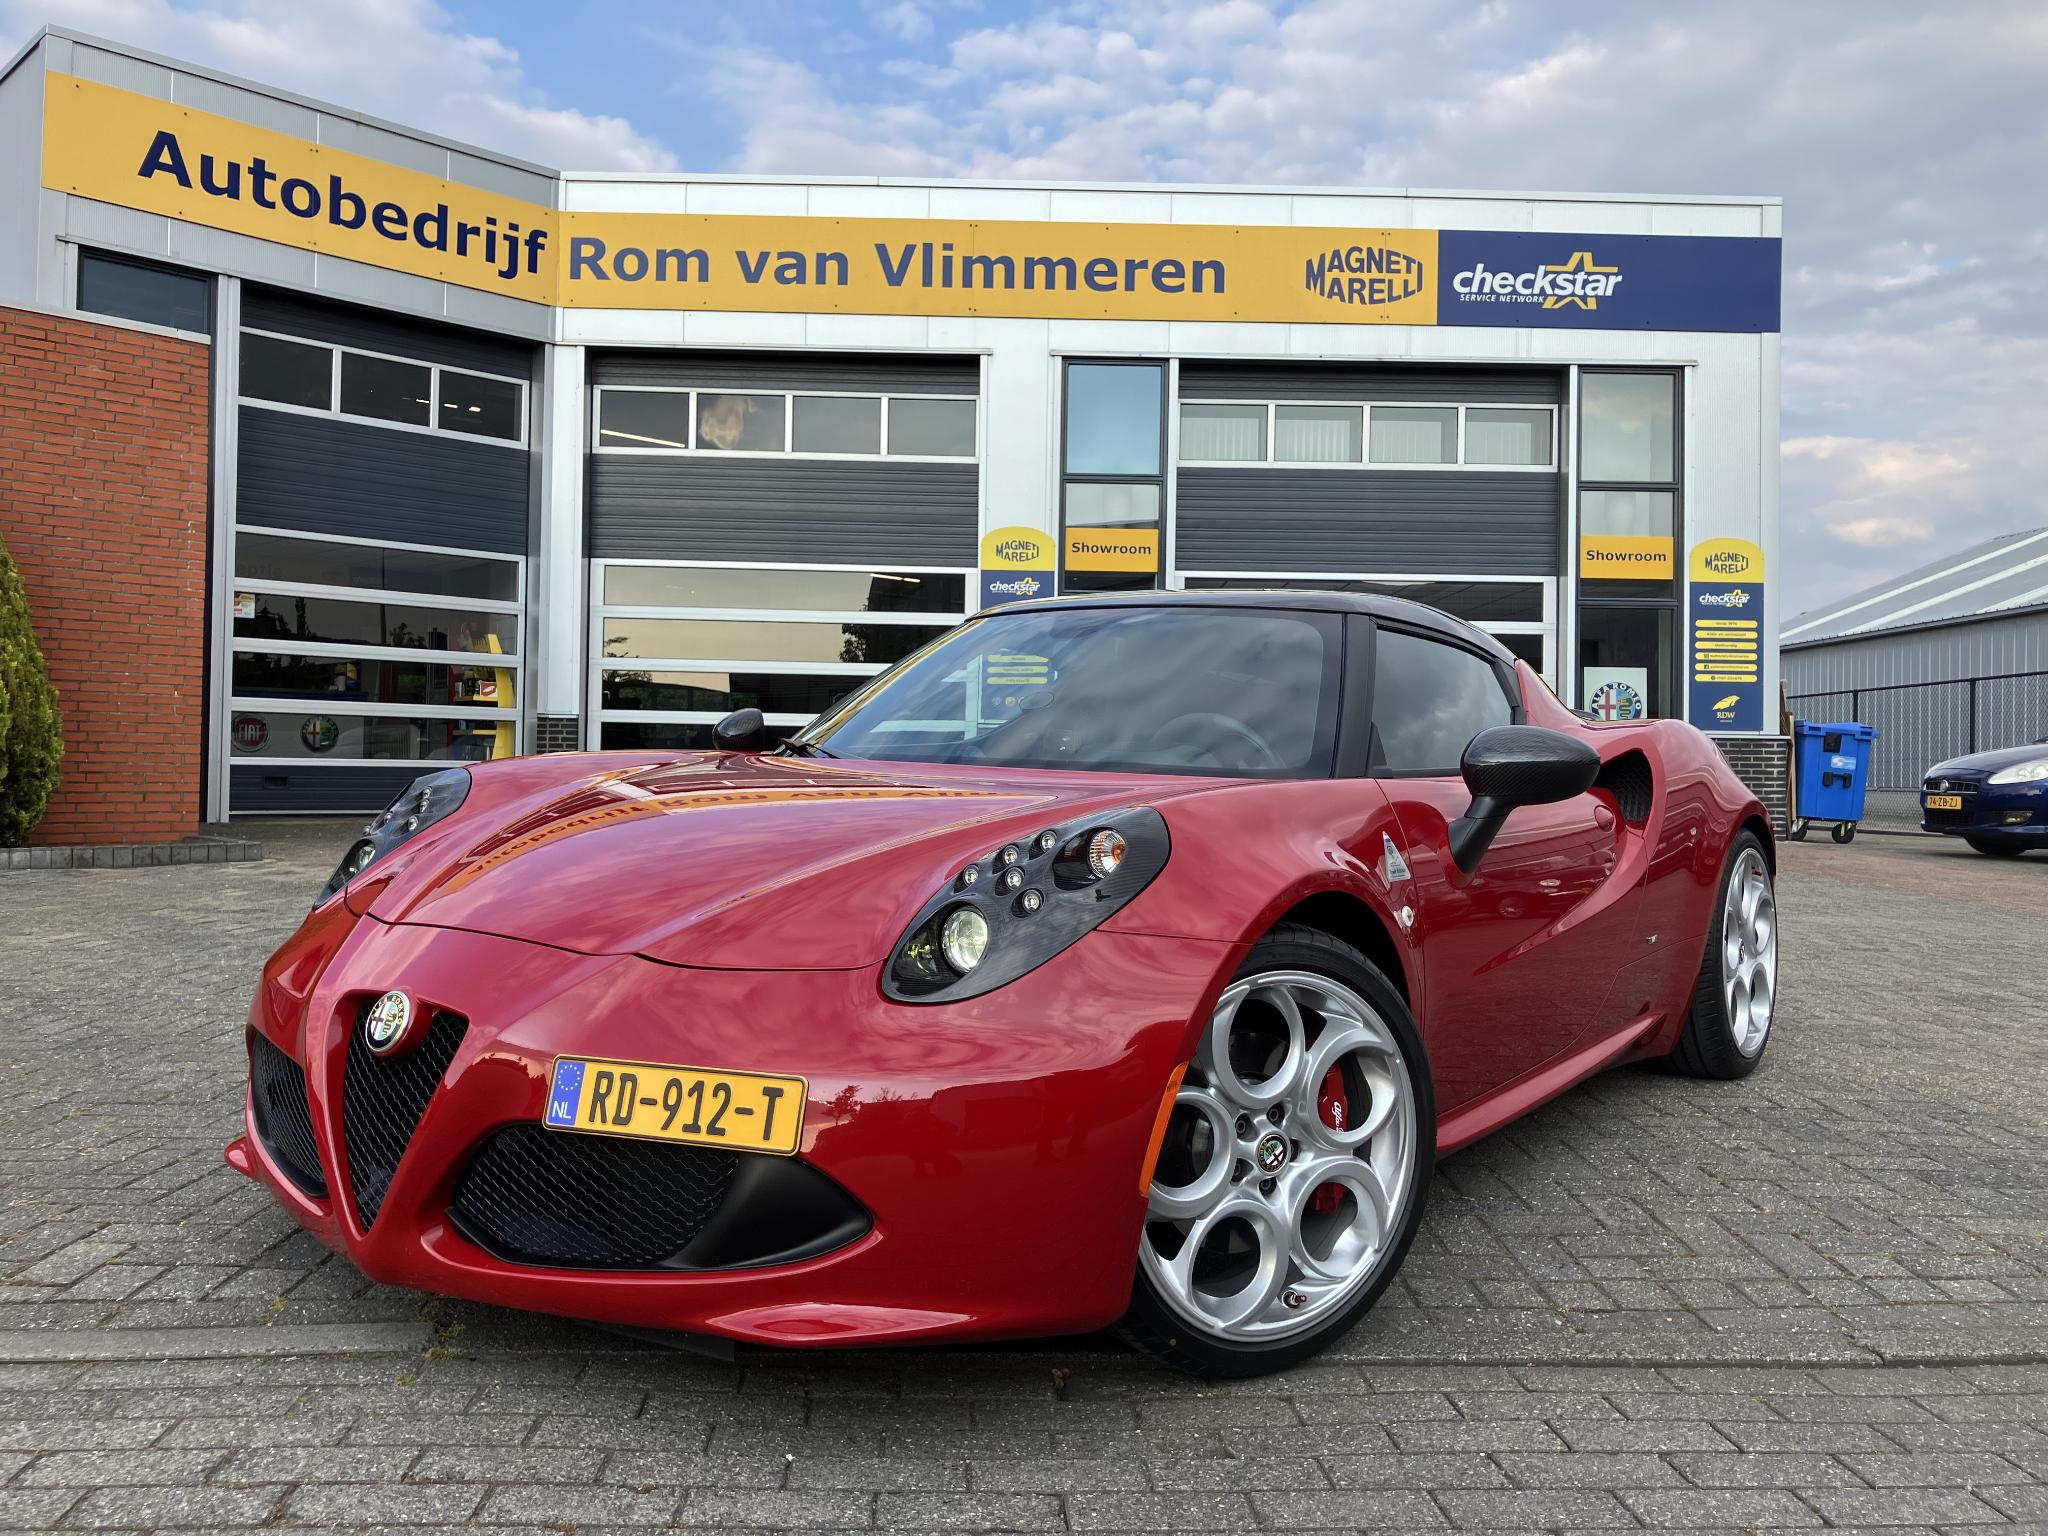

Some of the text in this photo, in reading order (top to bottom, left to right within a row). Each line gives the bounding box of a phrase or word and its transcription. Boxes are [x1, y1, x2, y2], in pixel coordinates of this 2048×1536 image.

[137, 130, 1226, 294] Autobedrijf Rom van Vlimmeren
[1305, 246, 1423, 284] MAGNETI
[1453, 263, 1623, 297] checkstar
[1459, 294, 1545, 303] SERVICE NETWORK
[996, 540, 1039, 555] MAGNETI
[1071, 542, 1152, 555] Showroom
[1586, 549, 1667, 562] Showroom
[1705, 552, 1749, 567] MAGNETI
[990, 580, 1041, 592] checkstar
[1699, 592, 1751, 604] checkstar
[1591, 682, 1642, 710] ALFA ROMEO
[1716, 711, 1736, 719] RDW
[238, 724, 261, 741] FIAT
[551, 1100, 573, 1120] NL
[588, 1070, 785, 1141] RD-912-T
